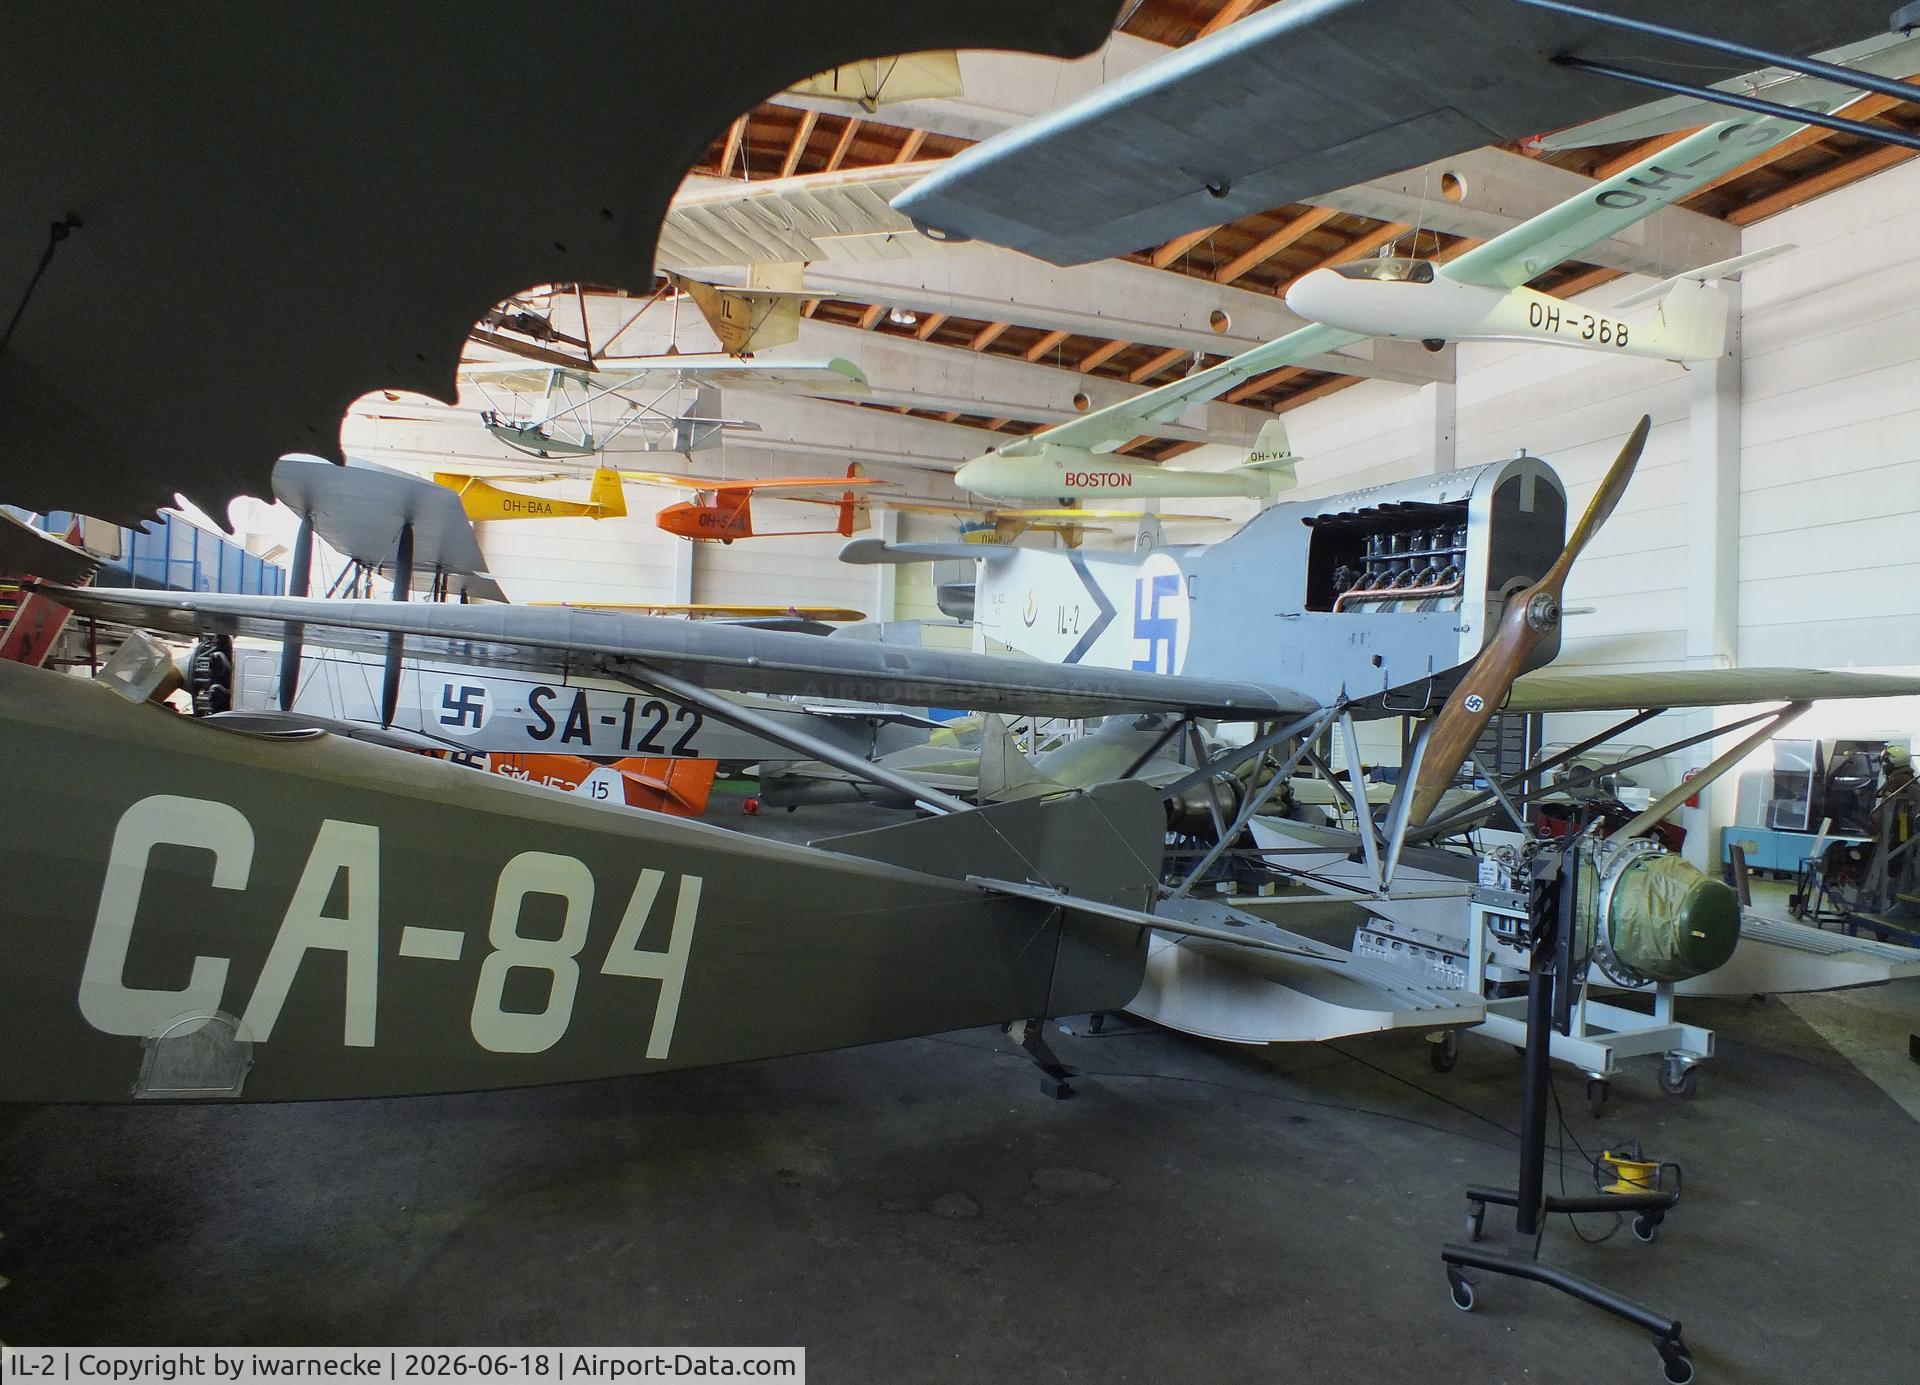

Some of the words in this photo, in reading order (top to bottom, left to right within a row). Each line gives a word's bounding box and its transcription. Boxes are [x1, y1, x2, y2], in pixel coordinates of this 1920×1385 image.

[1529, 301, 1629, 348] OH-368
[1064, 472, 1132, 487] BOSTON
[503, 499, 552, 514] OH-BAA
[1057, 604, 1080, 635] IL-2
[591, 780, 609, 800] 15
[78, 794, 704, 1060] CA-84
